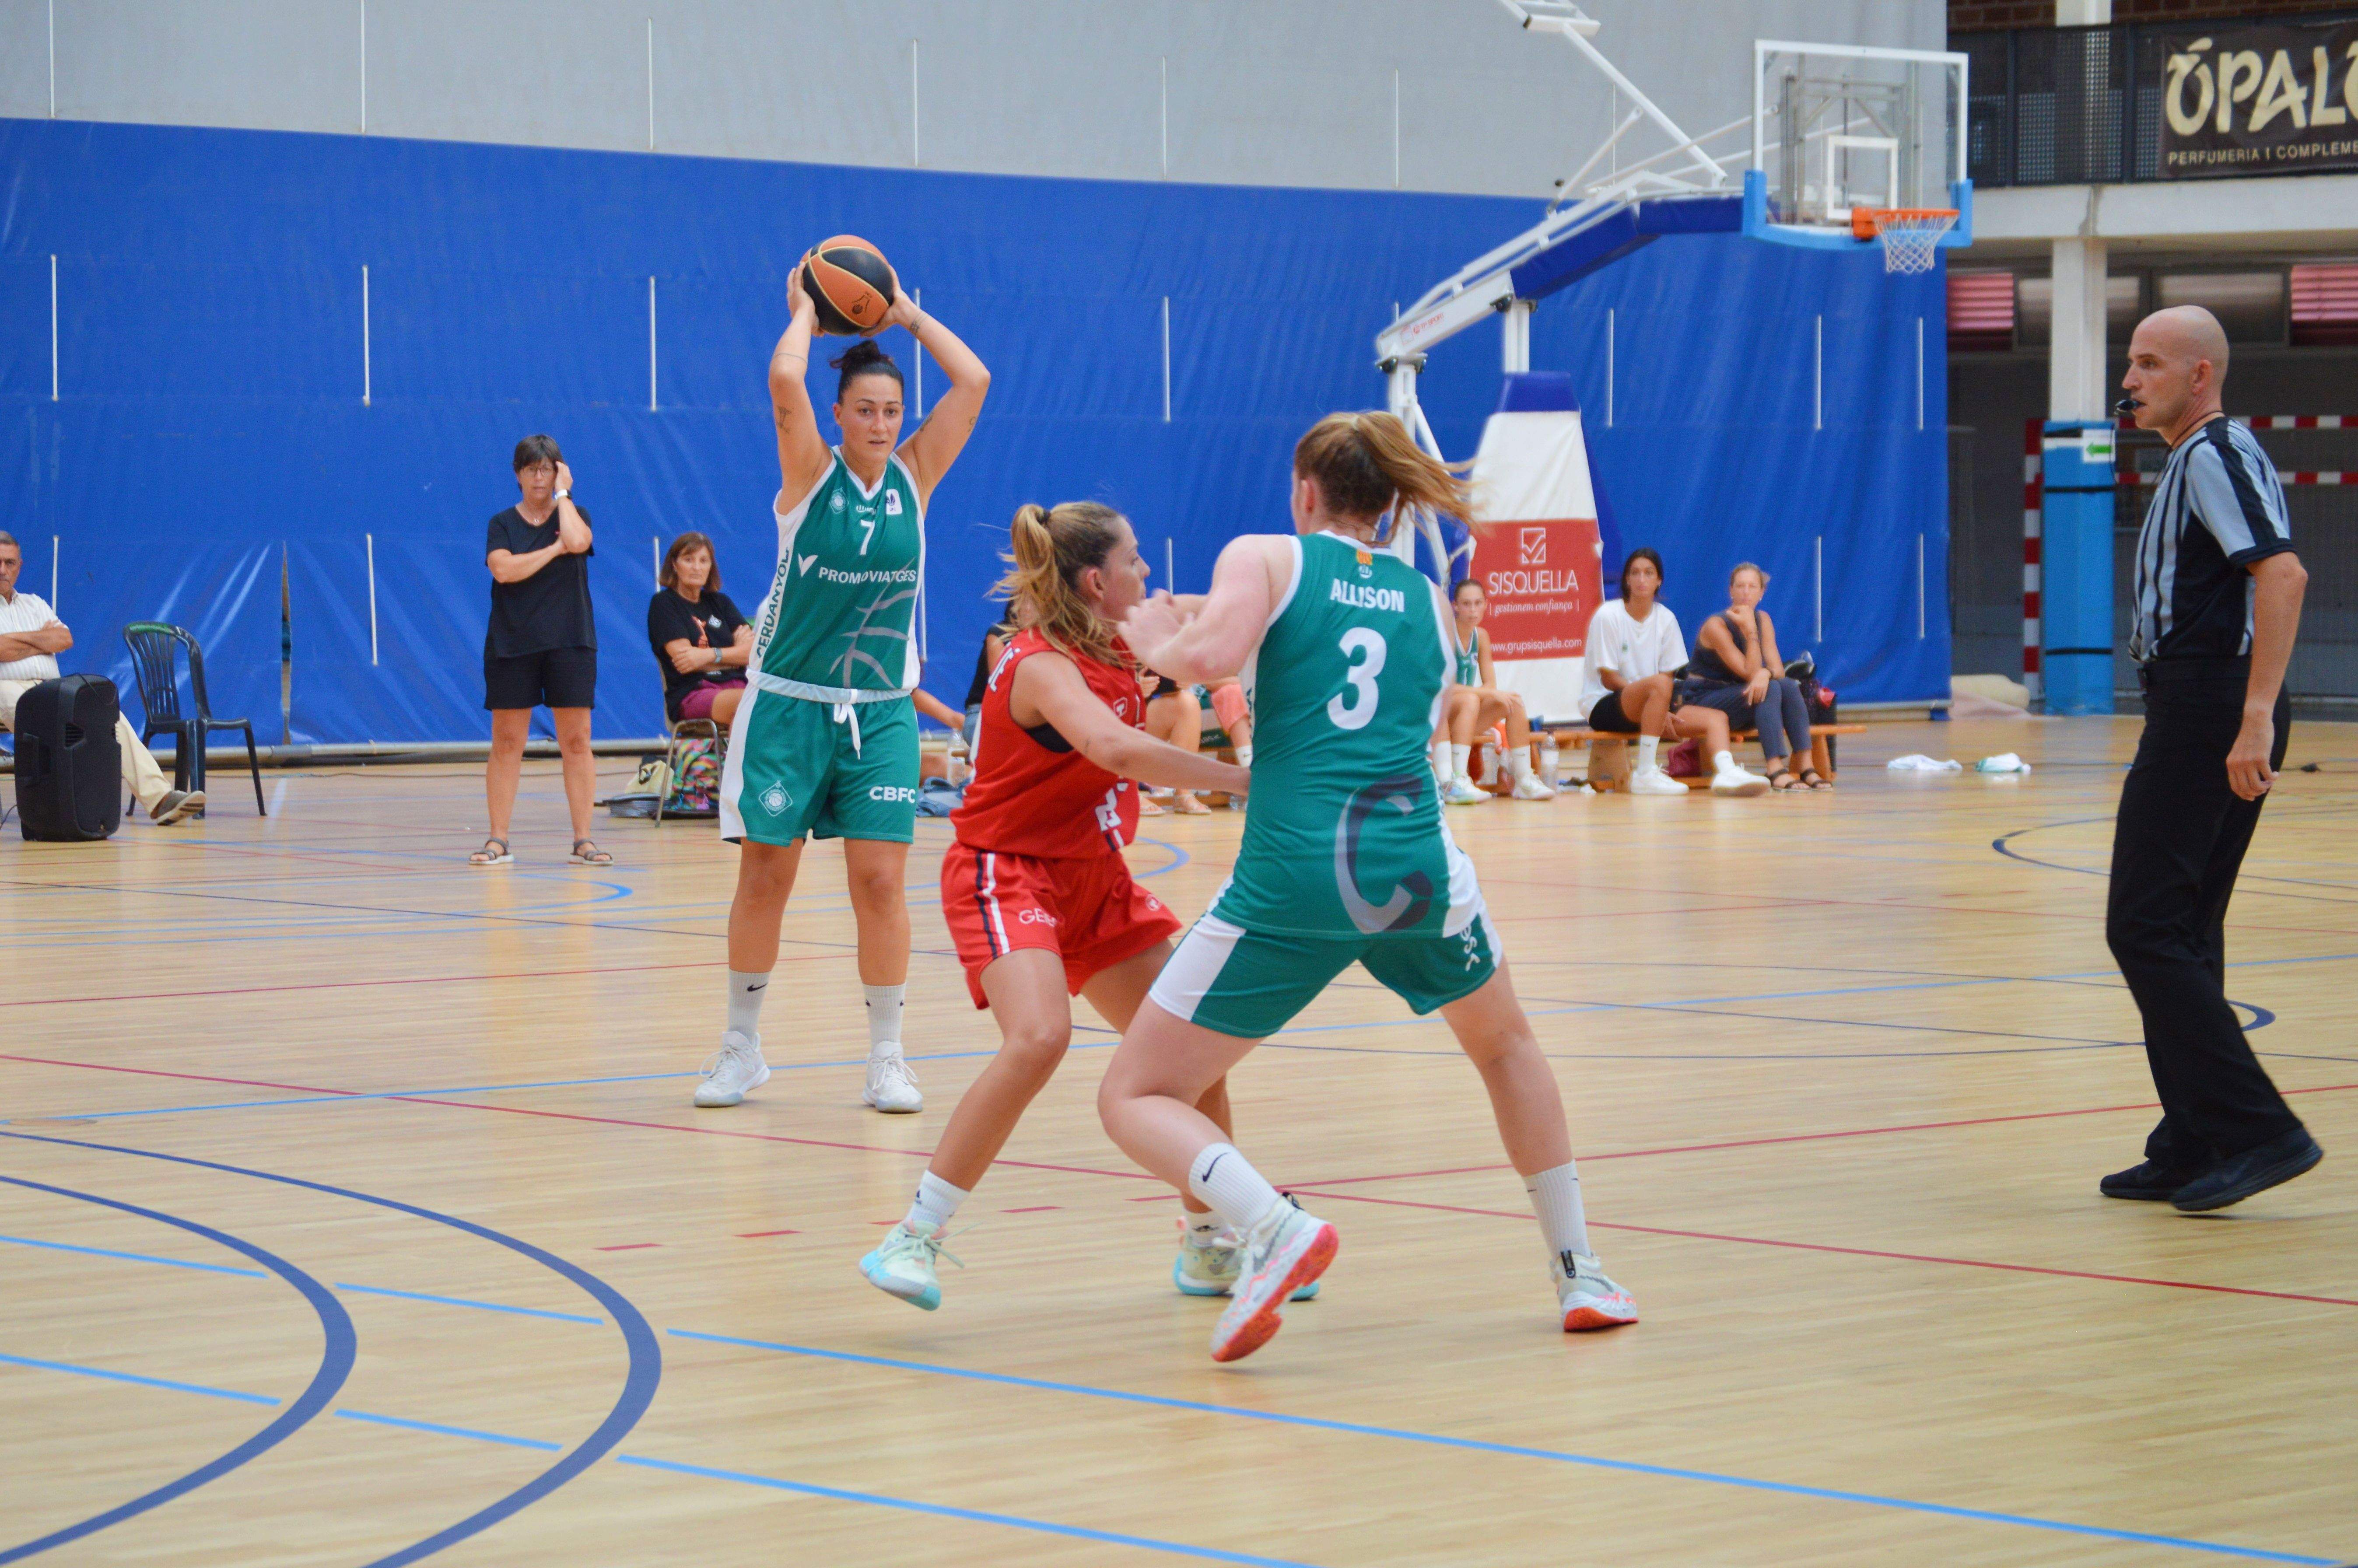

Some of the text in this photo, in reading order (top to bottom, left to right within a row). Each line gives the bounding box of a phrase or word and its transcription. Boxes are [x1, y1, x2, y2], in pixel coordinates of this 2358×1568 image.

[2168, 148, 2260, 165] PERFUMERIA
[2266, 147, 2270, 161] I
[859, 519, 875, 555] 7
[818, 566, 917, 584] PROMOVIATGES
[1489, 569, 1579, 595] SISQUELLA
[756, 547, 790, 659] CERDANYOL
[1329, 578, 1405, 613] ALLISON
[1494, 598, 1573, 617] gestionem confiança
[1327, 626, 1387, 730] 3
[869, 786, 916, 804] CBFC
